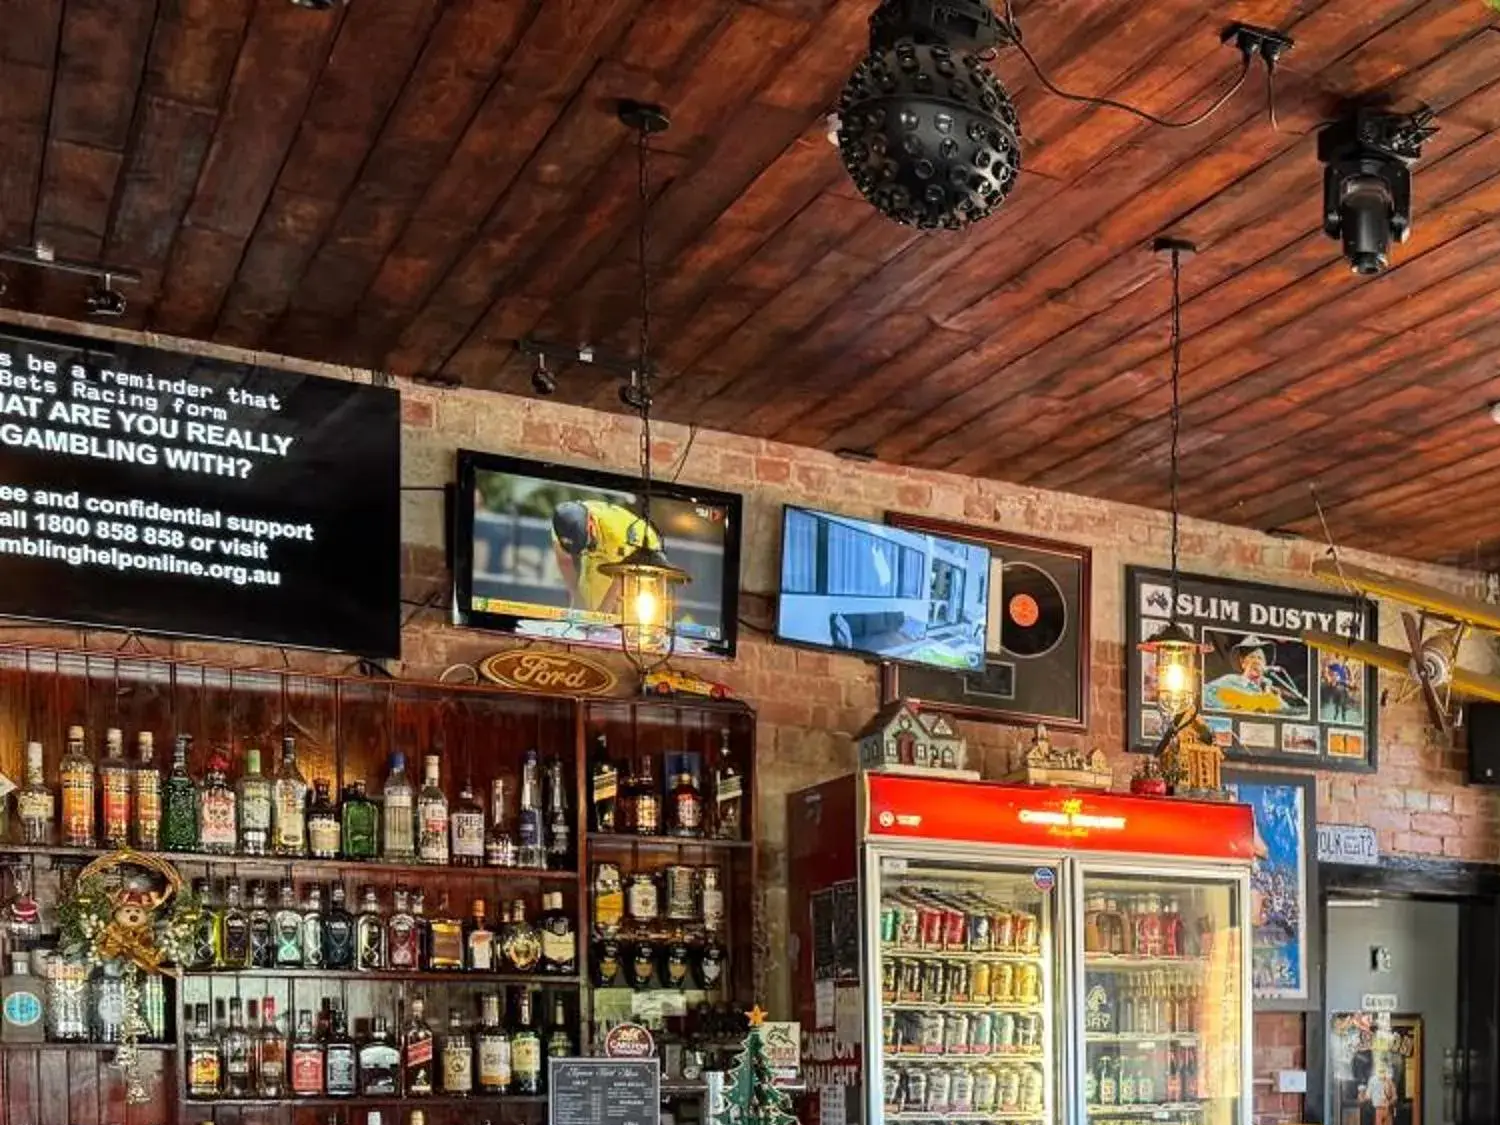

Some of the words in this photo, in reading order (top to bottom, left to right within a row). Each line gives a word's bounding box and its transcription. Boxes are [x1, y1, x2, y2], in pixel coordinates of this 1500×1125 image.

[27, 353, 57, 374] be
[71, 364, 87, 382] a
[101, 369, 214, 400] reminder
[226, 386, 282, 411] that
[72, 381, 159, 412] Racing
[172, 398, 228, 421] form
[1, 423, 158, 466] GAMBLING
[164, 447, 253, 479] WITH?
[48, 401, 112, 429] ARE
[117, 410, 179, 440] YOU
[186, 421, 294, 456] REALLY
[33, 490, 80, 510] and
[85, 495, 221, 529] confidential
[227, 515, 315, 545] support
[34, 513, 90, 537] 1800
[98, 522, 138, 543] 858
[143, 527, 184, 549] 858
[190, 536, 216, 554] or
[219, 538, 269, 560] visit
[1176, 593, 1240, 622] SLIM
[1250, 602, 1336, 632] DUSTY
[513, 655, 586, 688] Ford
